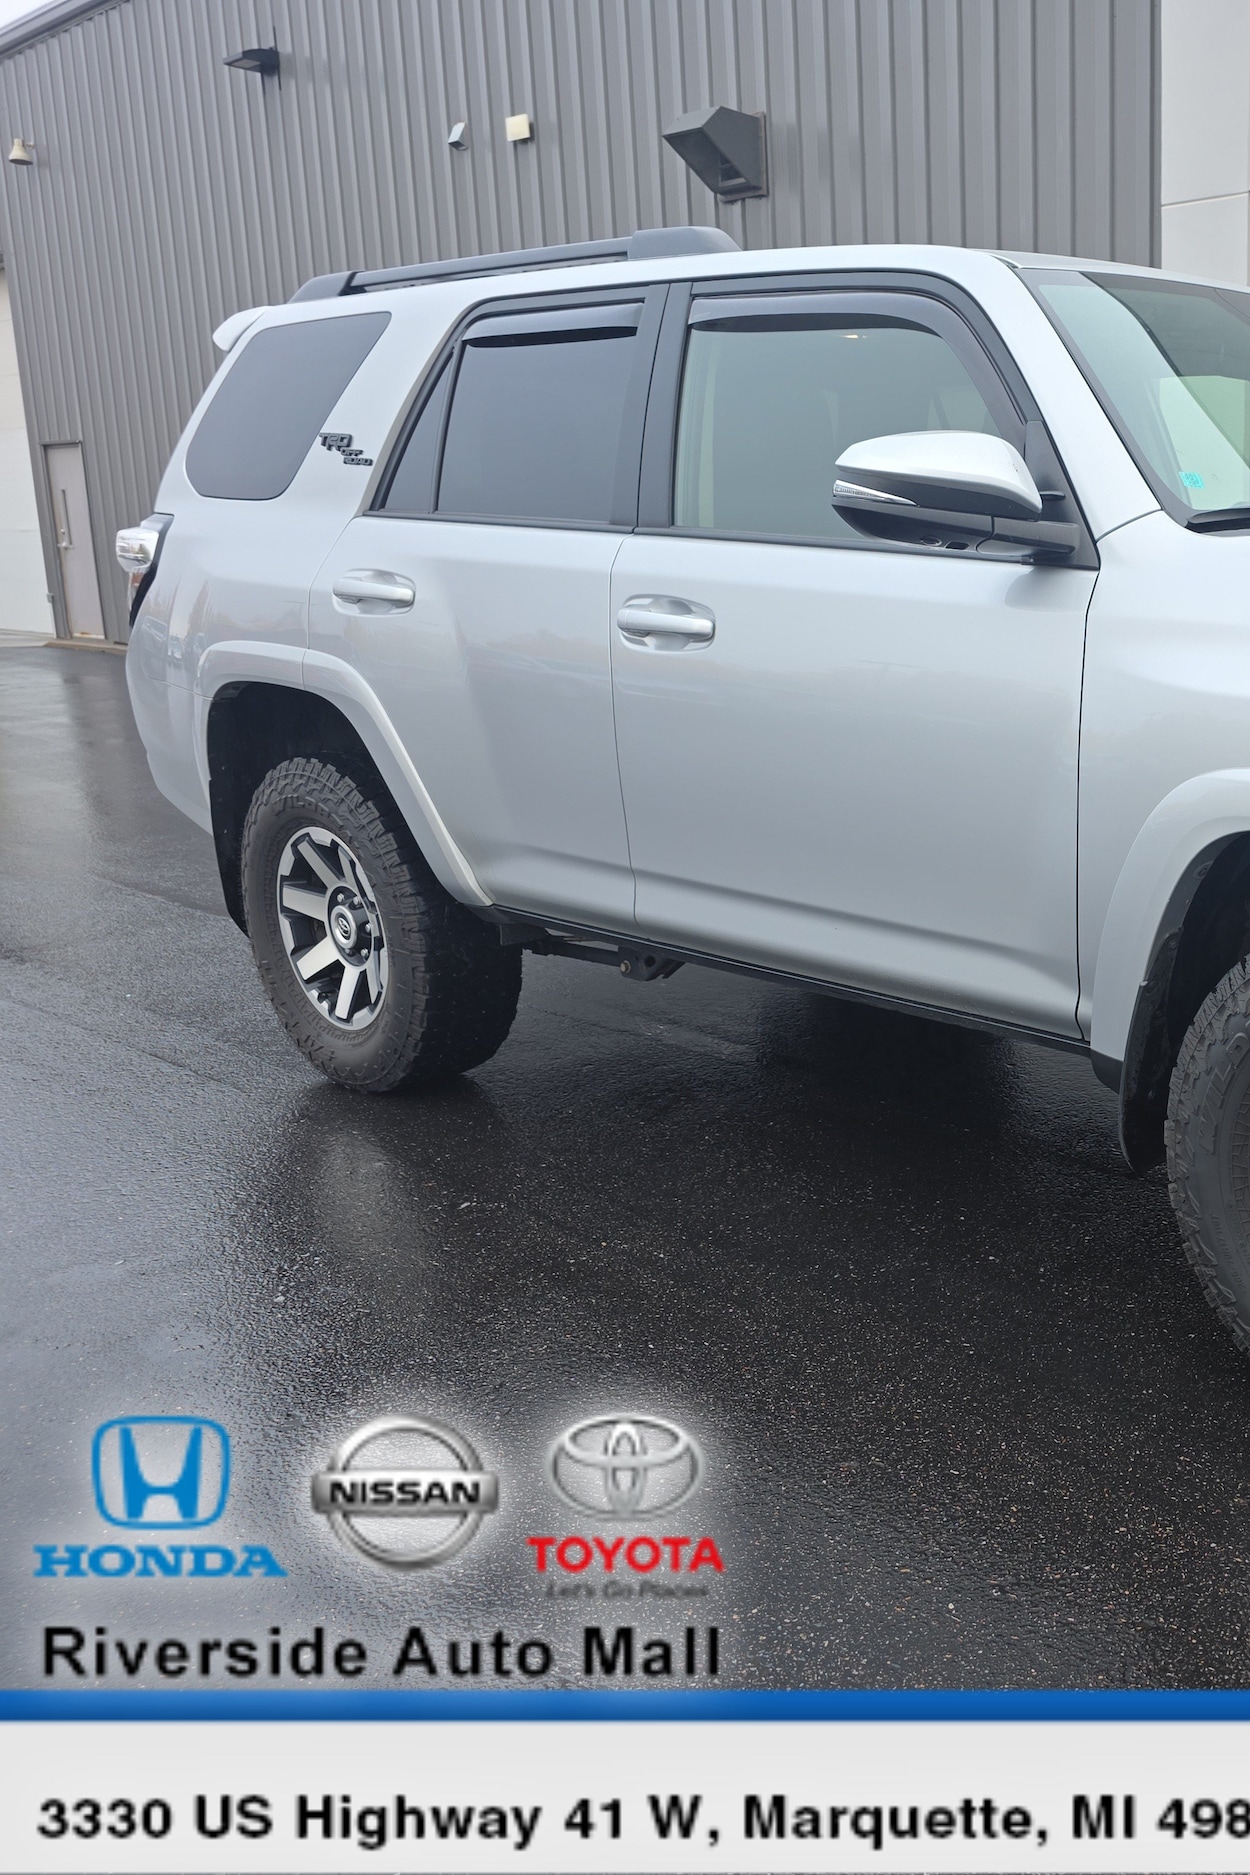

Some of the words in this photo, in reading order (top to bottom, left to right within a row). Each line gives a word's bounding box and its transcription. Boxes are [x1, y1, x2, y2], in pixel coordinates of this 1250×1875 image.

[319, 432, 353, 451] TRD
[340, 447, 364, 457] OFF
[343, 457, 373, 466] ROAD
